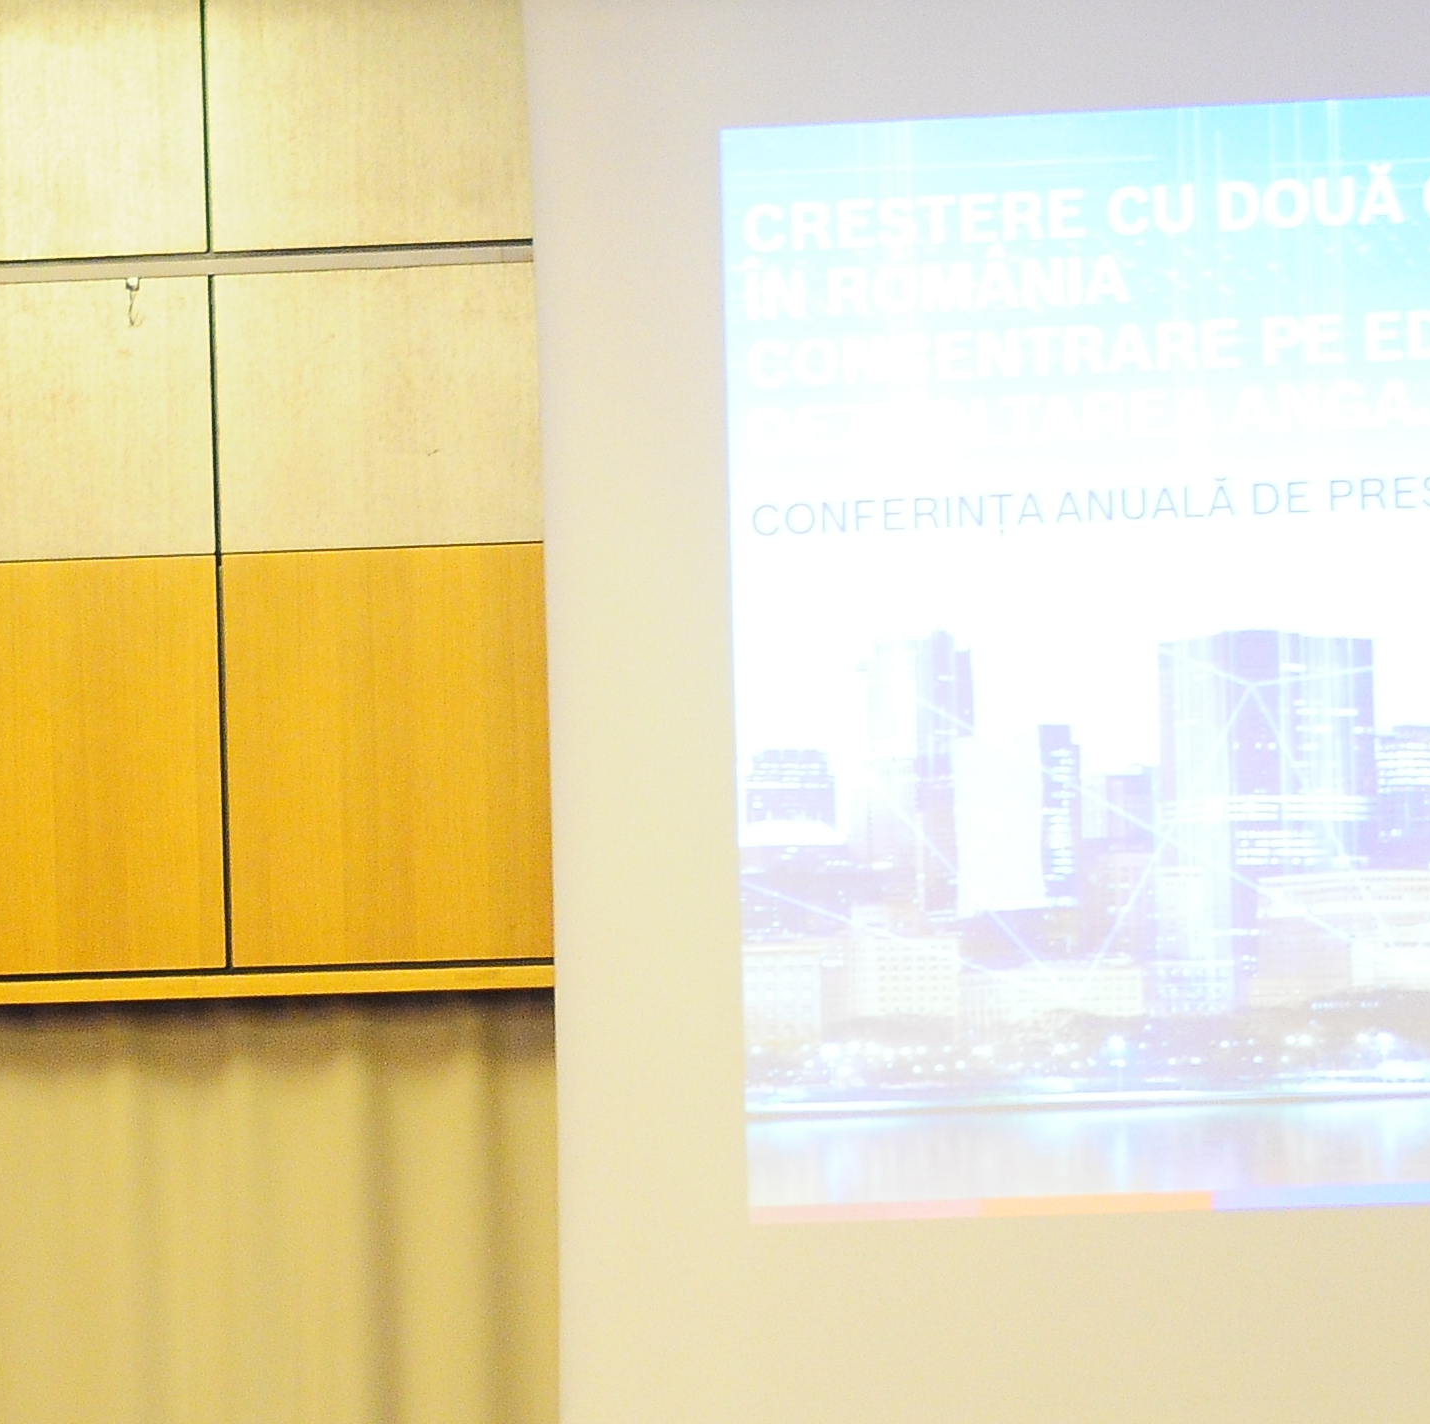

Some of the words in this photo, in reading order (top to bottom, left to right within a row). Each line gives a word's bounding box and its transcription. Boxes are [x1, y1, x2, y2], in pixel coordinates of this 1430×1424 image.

[1106, 182, 1196, 236] CU
[1218, 161, 1405, 232] DOUĂ
[828, 243, 1133, 318] ROMÂNIA
[1262, 313, 1345, 366] PE
[1055, 475, 1238, 525] ANUALĂ
[1251, 479, 1312, 517] DE
